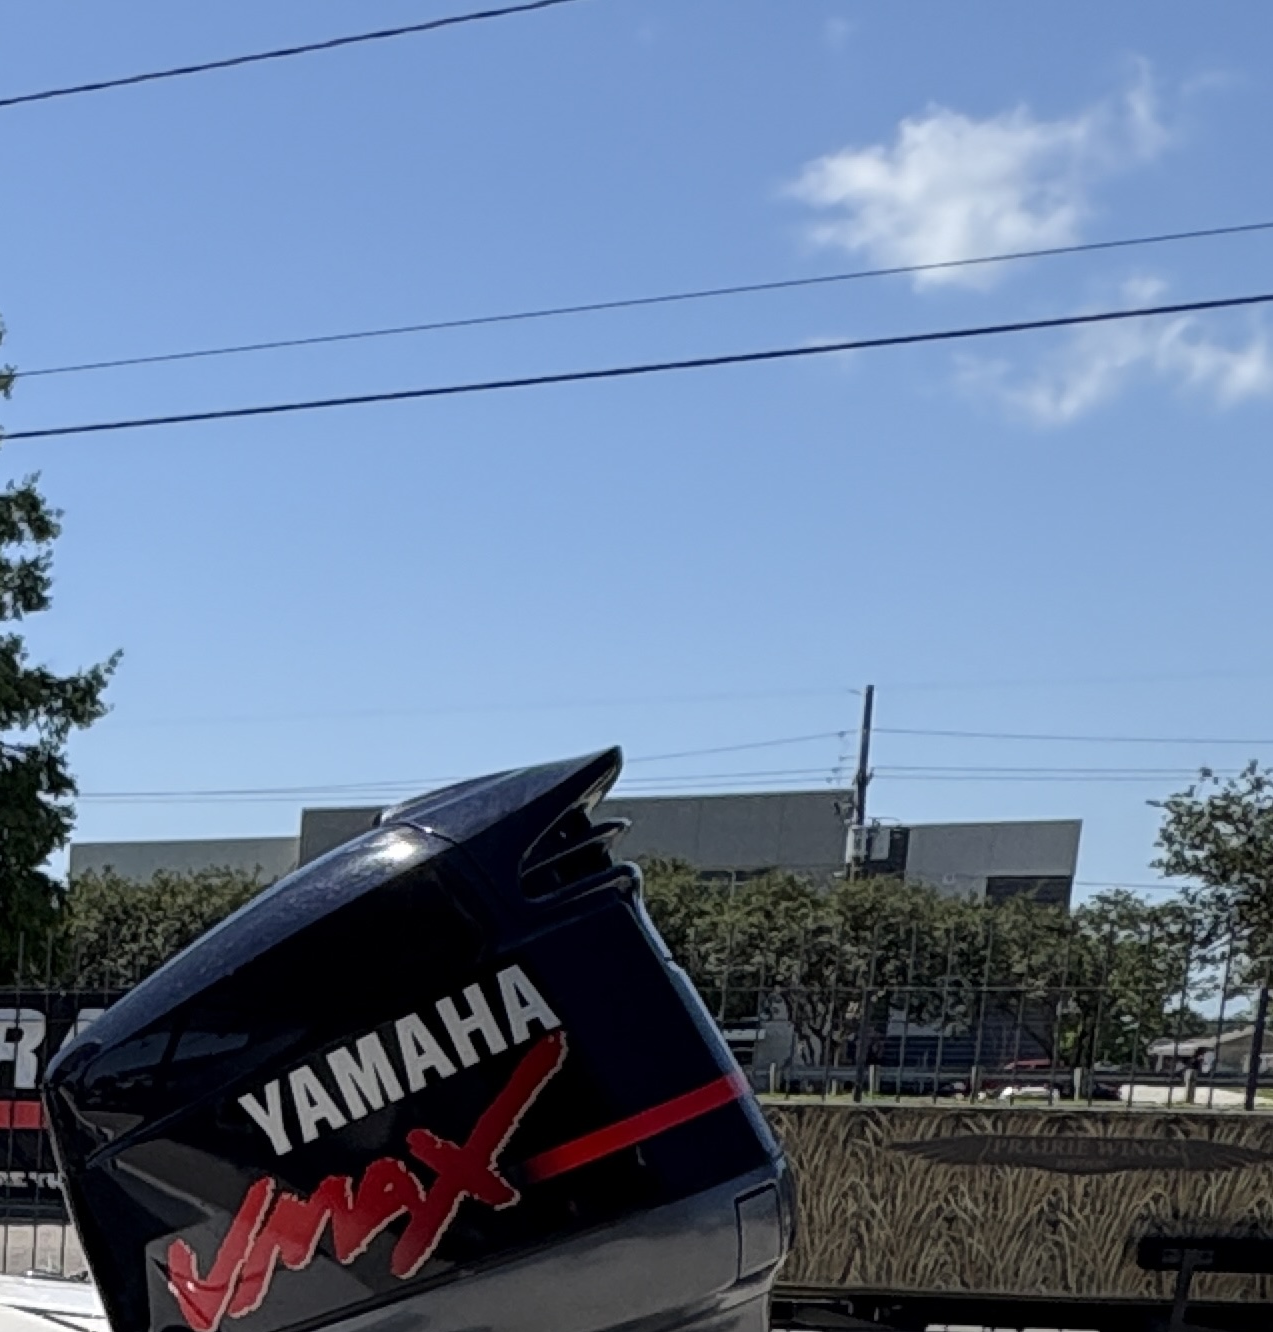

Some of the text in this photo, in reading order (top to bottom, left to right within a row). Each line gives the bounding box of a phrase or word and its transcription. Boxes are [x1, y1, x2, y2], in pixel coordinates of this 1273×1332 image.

[237, 964, 562, 1156] YAMAHA
[993, 1137, 1179, 1158] PRAIRIE WINGS
